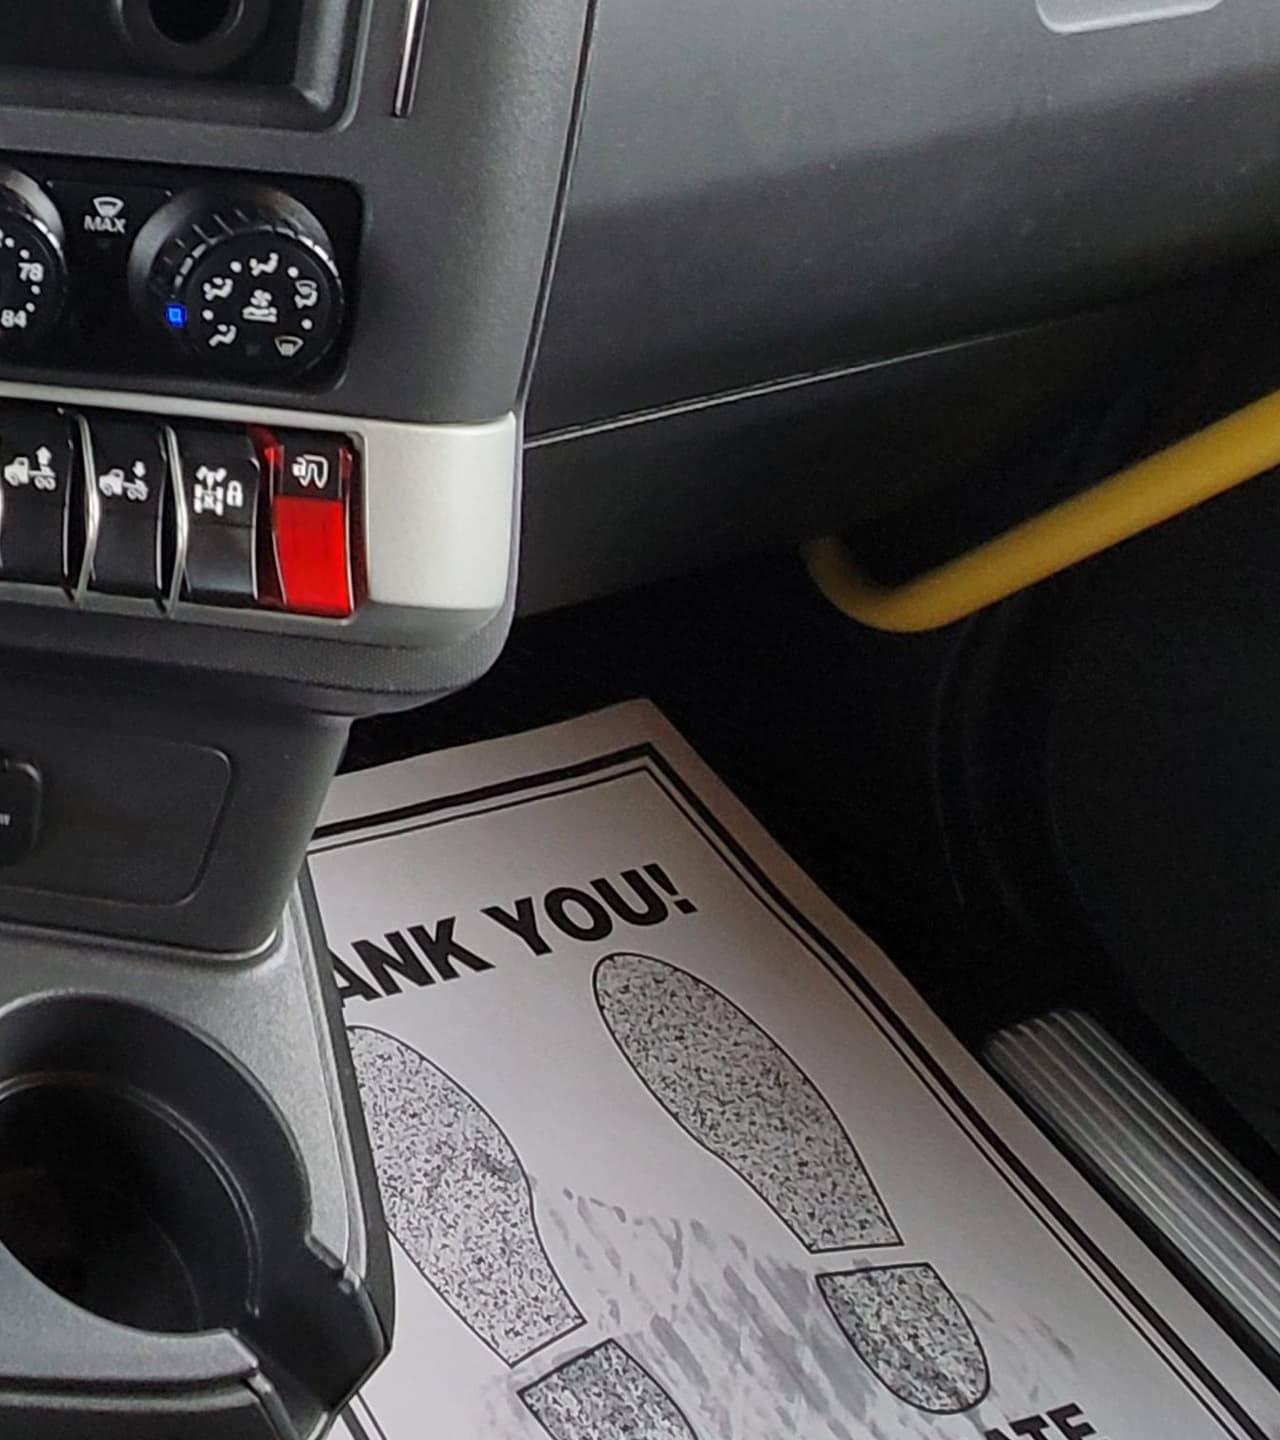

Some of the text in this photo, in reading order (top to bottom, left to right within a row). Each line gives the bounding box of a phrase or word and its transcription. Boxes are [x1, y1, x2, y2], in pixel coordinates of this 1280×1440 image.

[83, 215, 127, 234] MAX
[18, 262, 44, 282] 78
[0, 309, 28, 329] 84
[480, 863, 699, 957] YOU!
